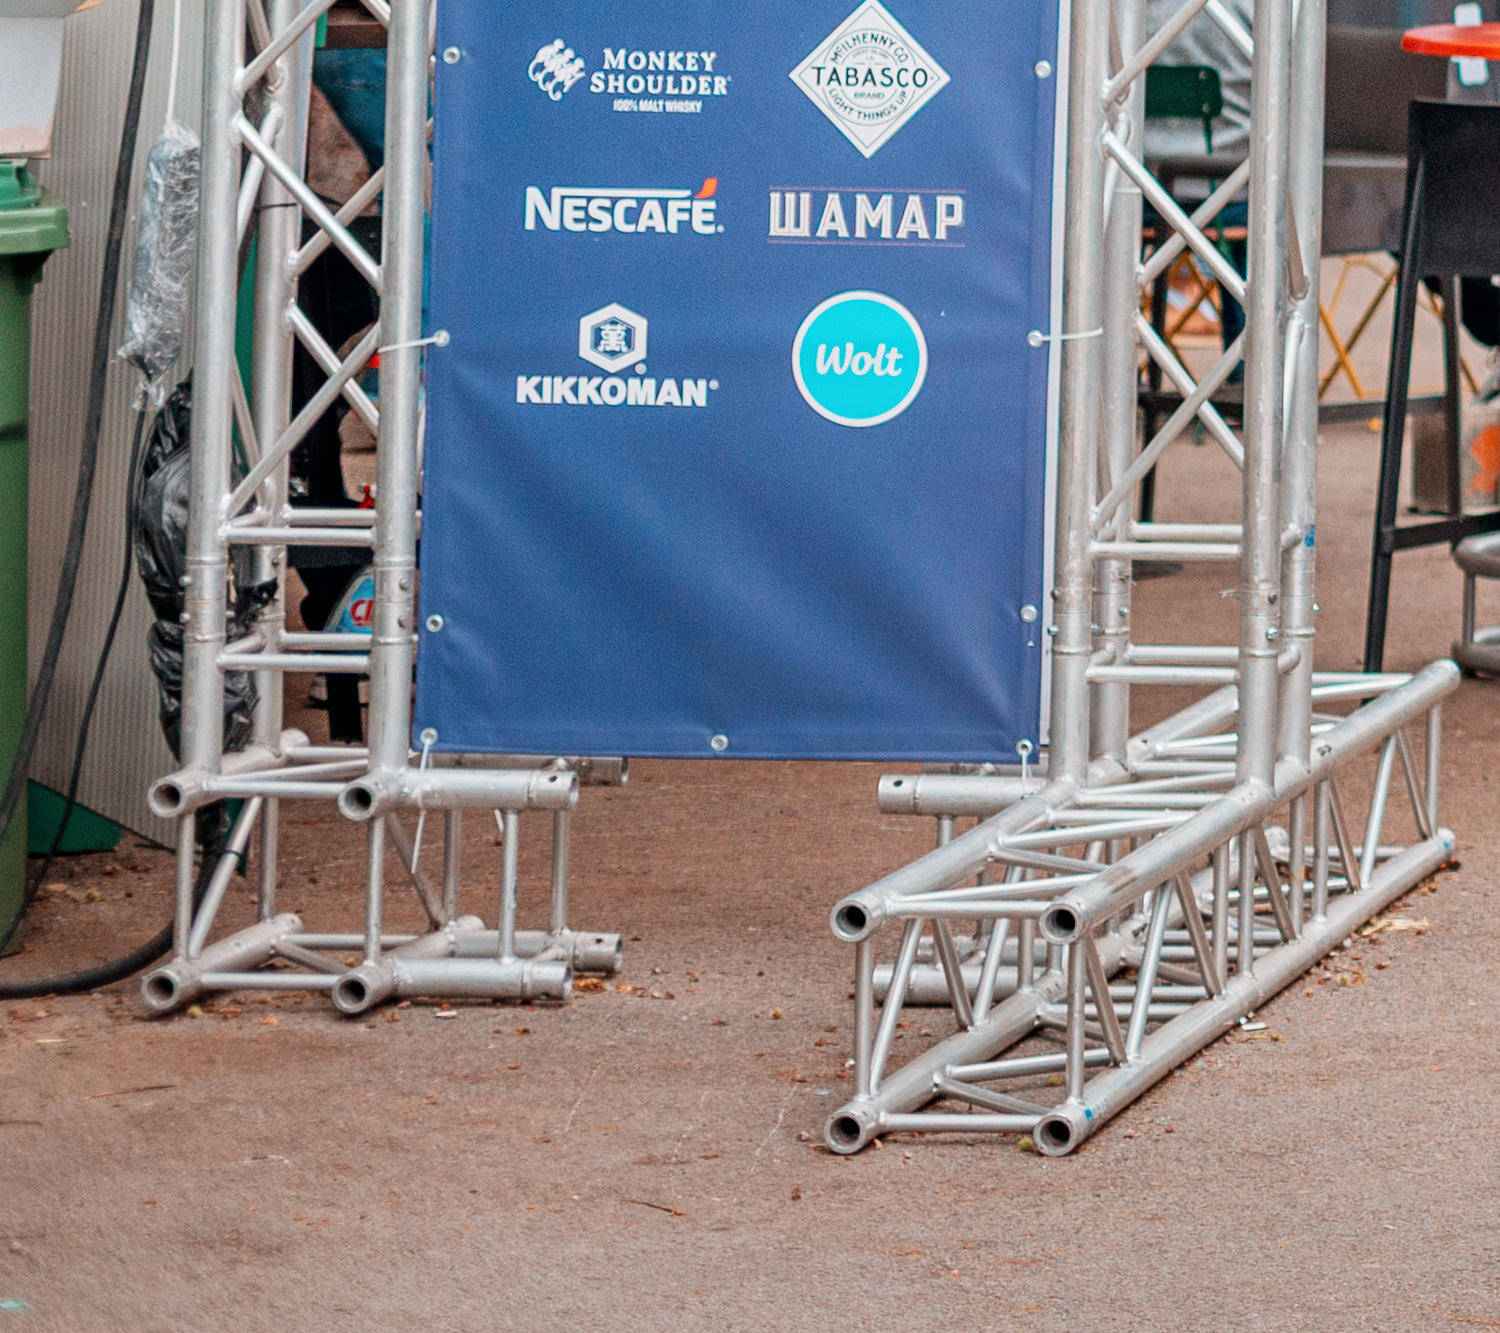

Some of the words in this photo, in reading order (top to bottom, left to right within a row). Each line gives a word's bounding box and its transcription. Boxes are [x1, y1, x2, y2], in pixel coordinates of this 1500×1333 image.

[602, 47, 717, 73] MONKEY
[590, 71, 728, 96] SHOULDER
[811, 66, 929, 90] TABASCO
[613, 99, 638, 112] 100%
[639, 100, 665, 113] MALT
[666, 100, 703, 114] WHISKY
[828, 87, 855, 118] LIGHT
[855, 106, 898, 122] THINGS
[895, 90, 909, 109] UP
[853, 90, 886, 101] BRAND
[523, 177, 719, 234] NESCAFÉ
[768, 191, 965, 240] ШАМАР
[816, 342, 905, 377] Wolt
[516, 375, 708, 407] KIKKOMAN
